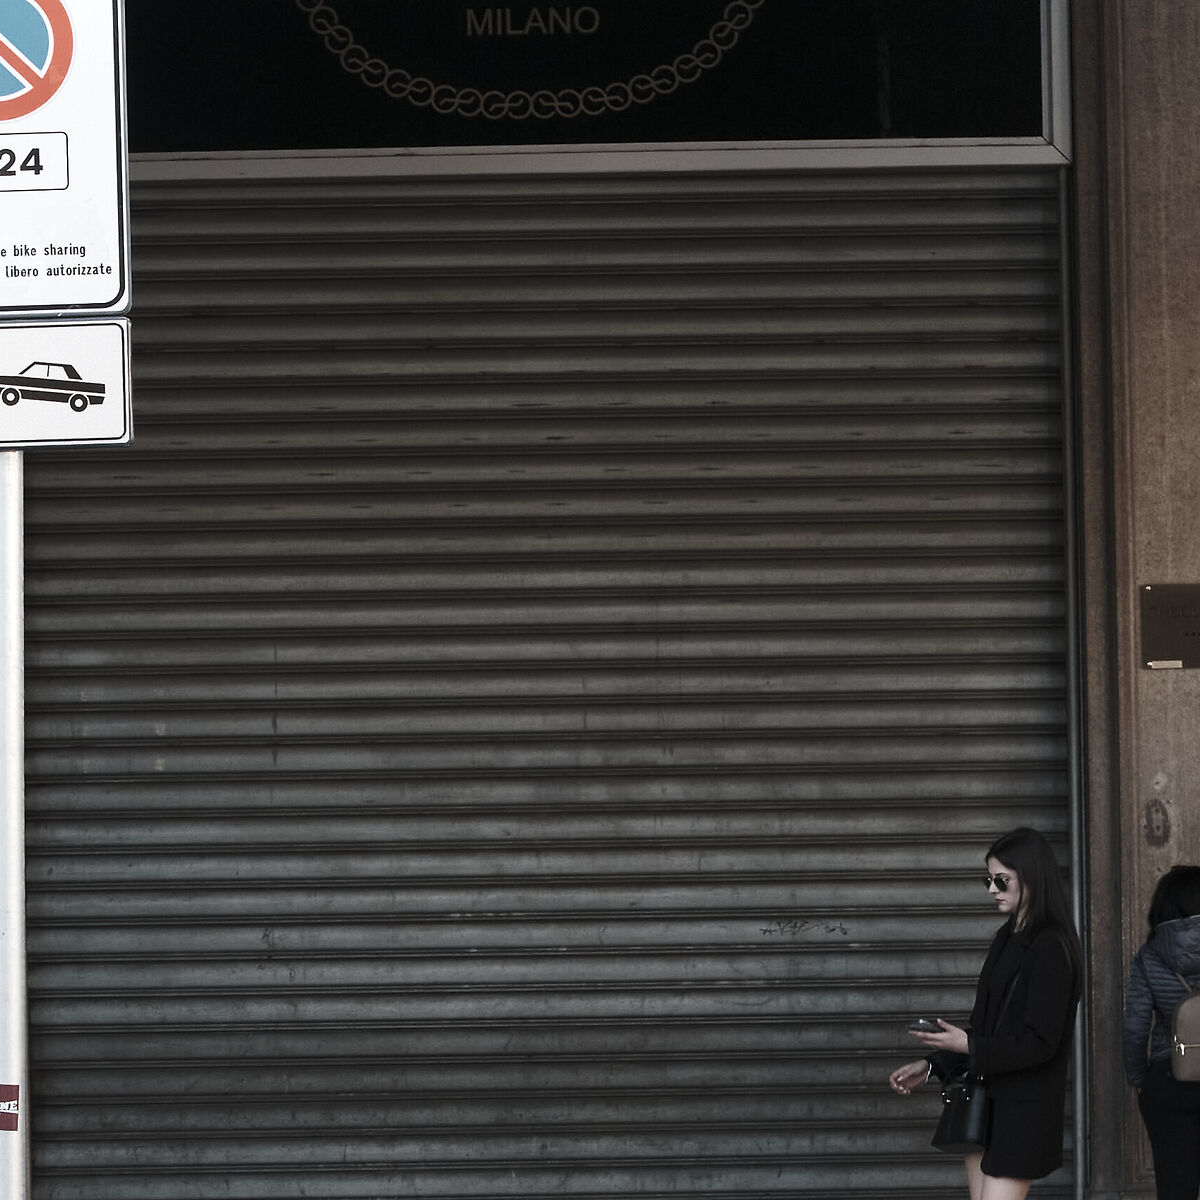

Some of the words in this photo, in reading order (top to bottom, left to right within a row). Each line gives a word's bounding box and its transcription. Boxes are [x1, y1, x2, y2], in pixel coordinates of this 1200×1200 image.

[465, 6, 600, 36] MILANO
[13, 244, 37, 257] bike
[44, 243, 86, 258] sharing
[5, 265, 39, 278] libero
[46, 263, 112, 276] autorizzate
